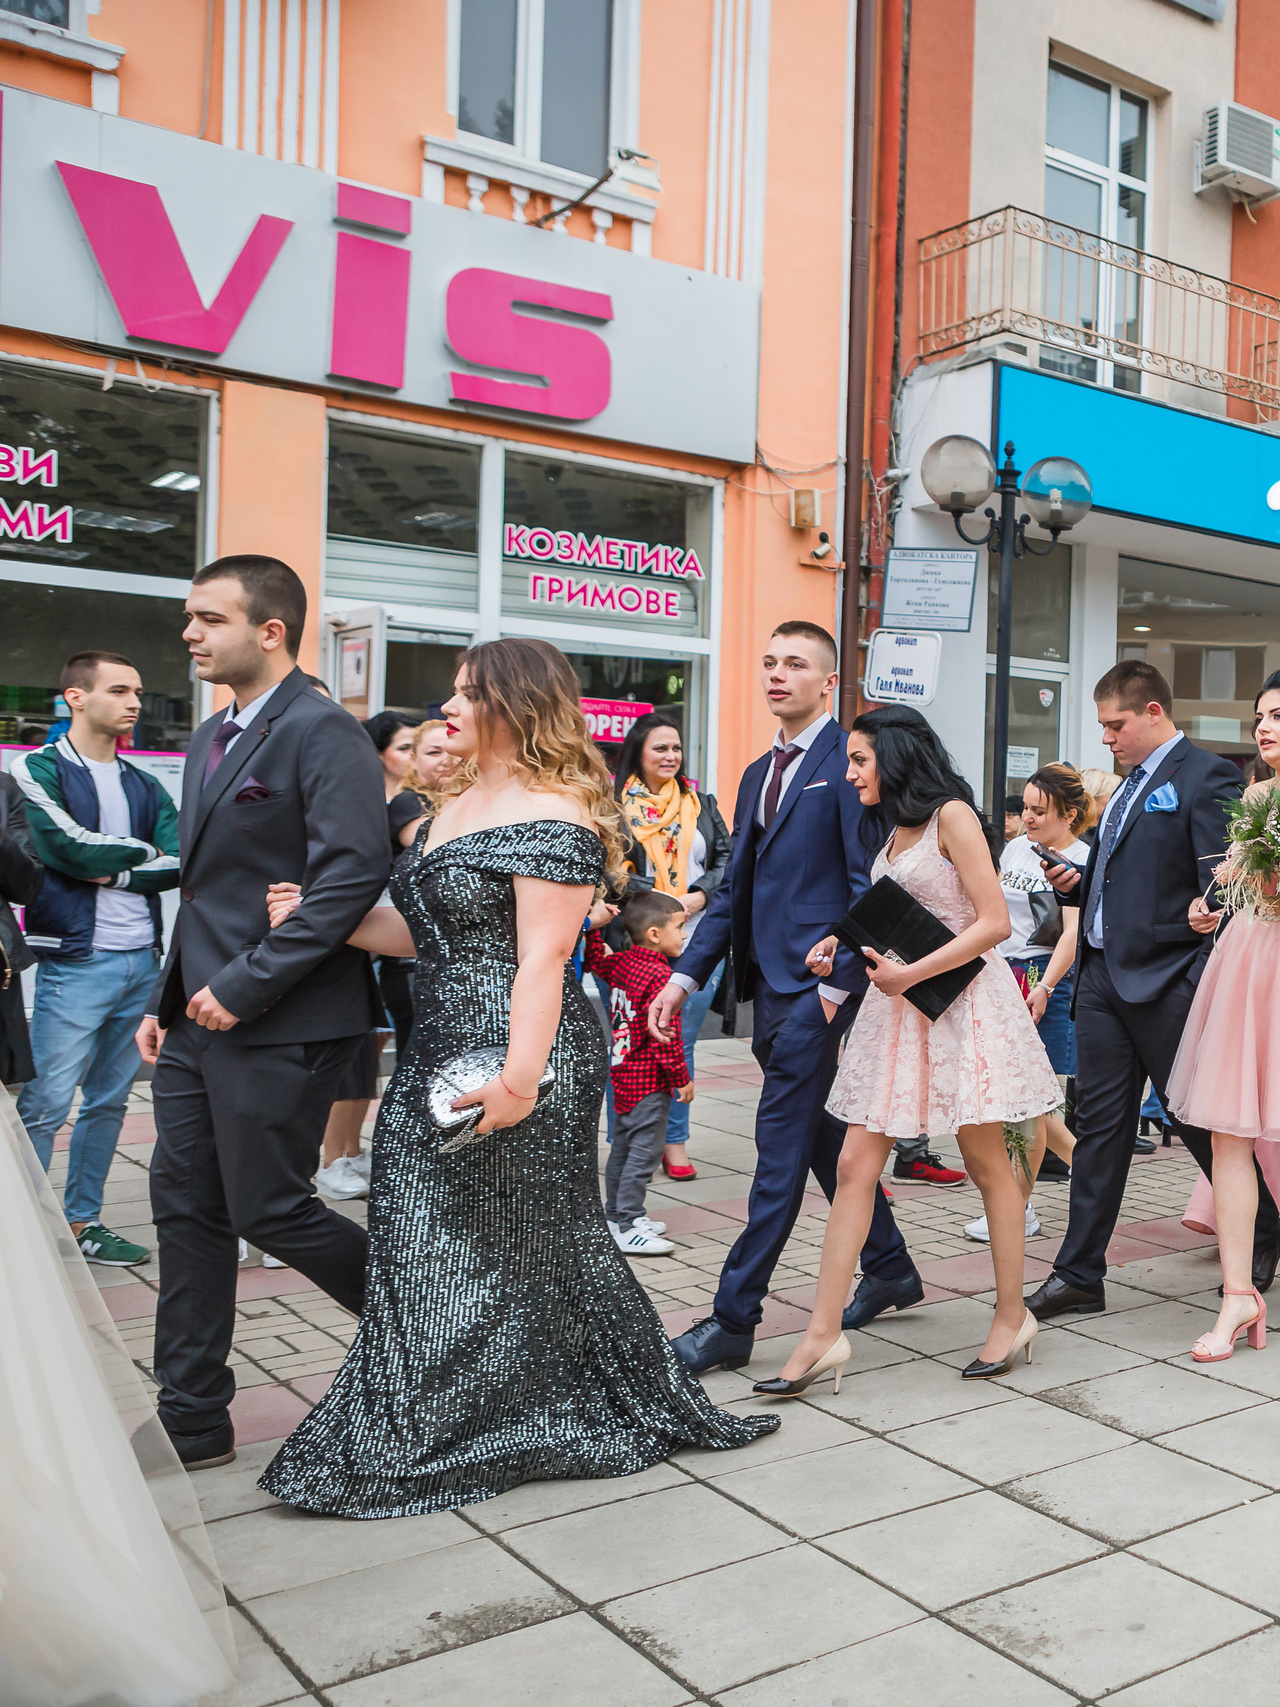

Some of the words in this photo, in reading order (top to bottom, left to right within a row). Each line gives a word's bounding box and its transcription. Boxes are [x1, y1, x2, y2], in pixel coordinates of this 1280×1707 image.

[0, 90, 613, 420] vis
[504, 523, 705, 580] КОЗМЕТИКА
[893, 551, 939, 559] АДВОКАТСКА
[940, 551, 973, 560] КАНТОРА
[529, 571, 681, 619] ГРИМОВЕ
[895, 636, 918, 647] адвокат
[890, 666, 914, 677] адвокат
[875, 676, 893, 692] Галя
[894, 679, 925, 696] Иванова
